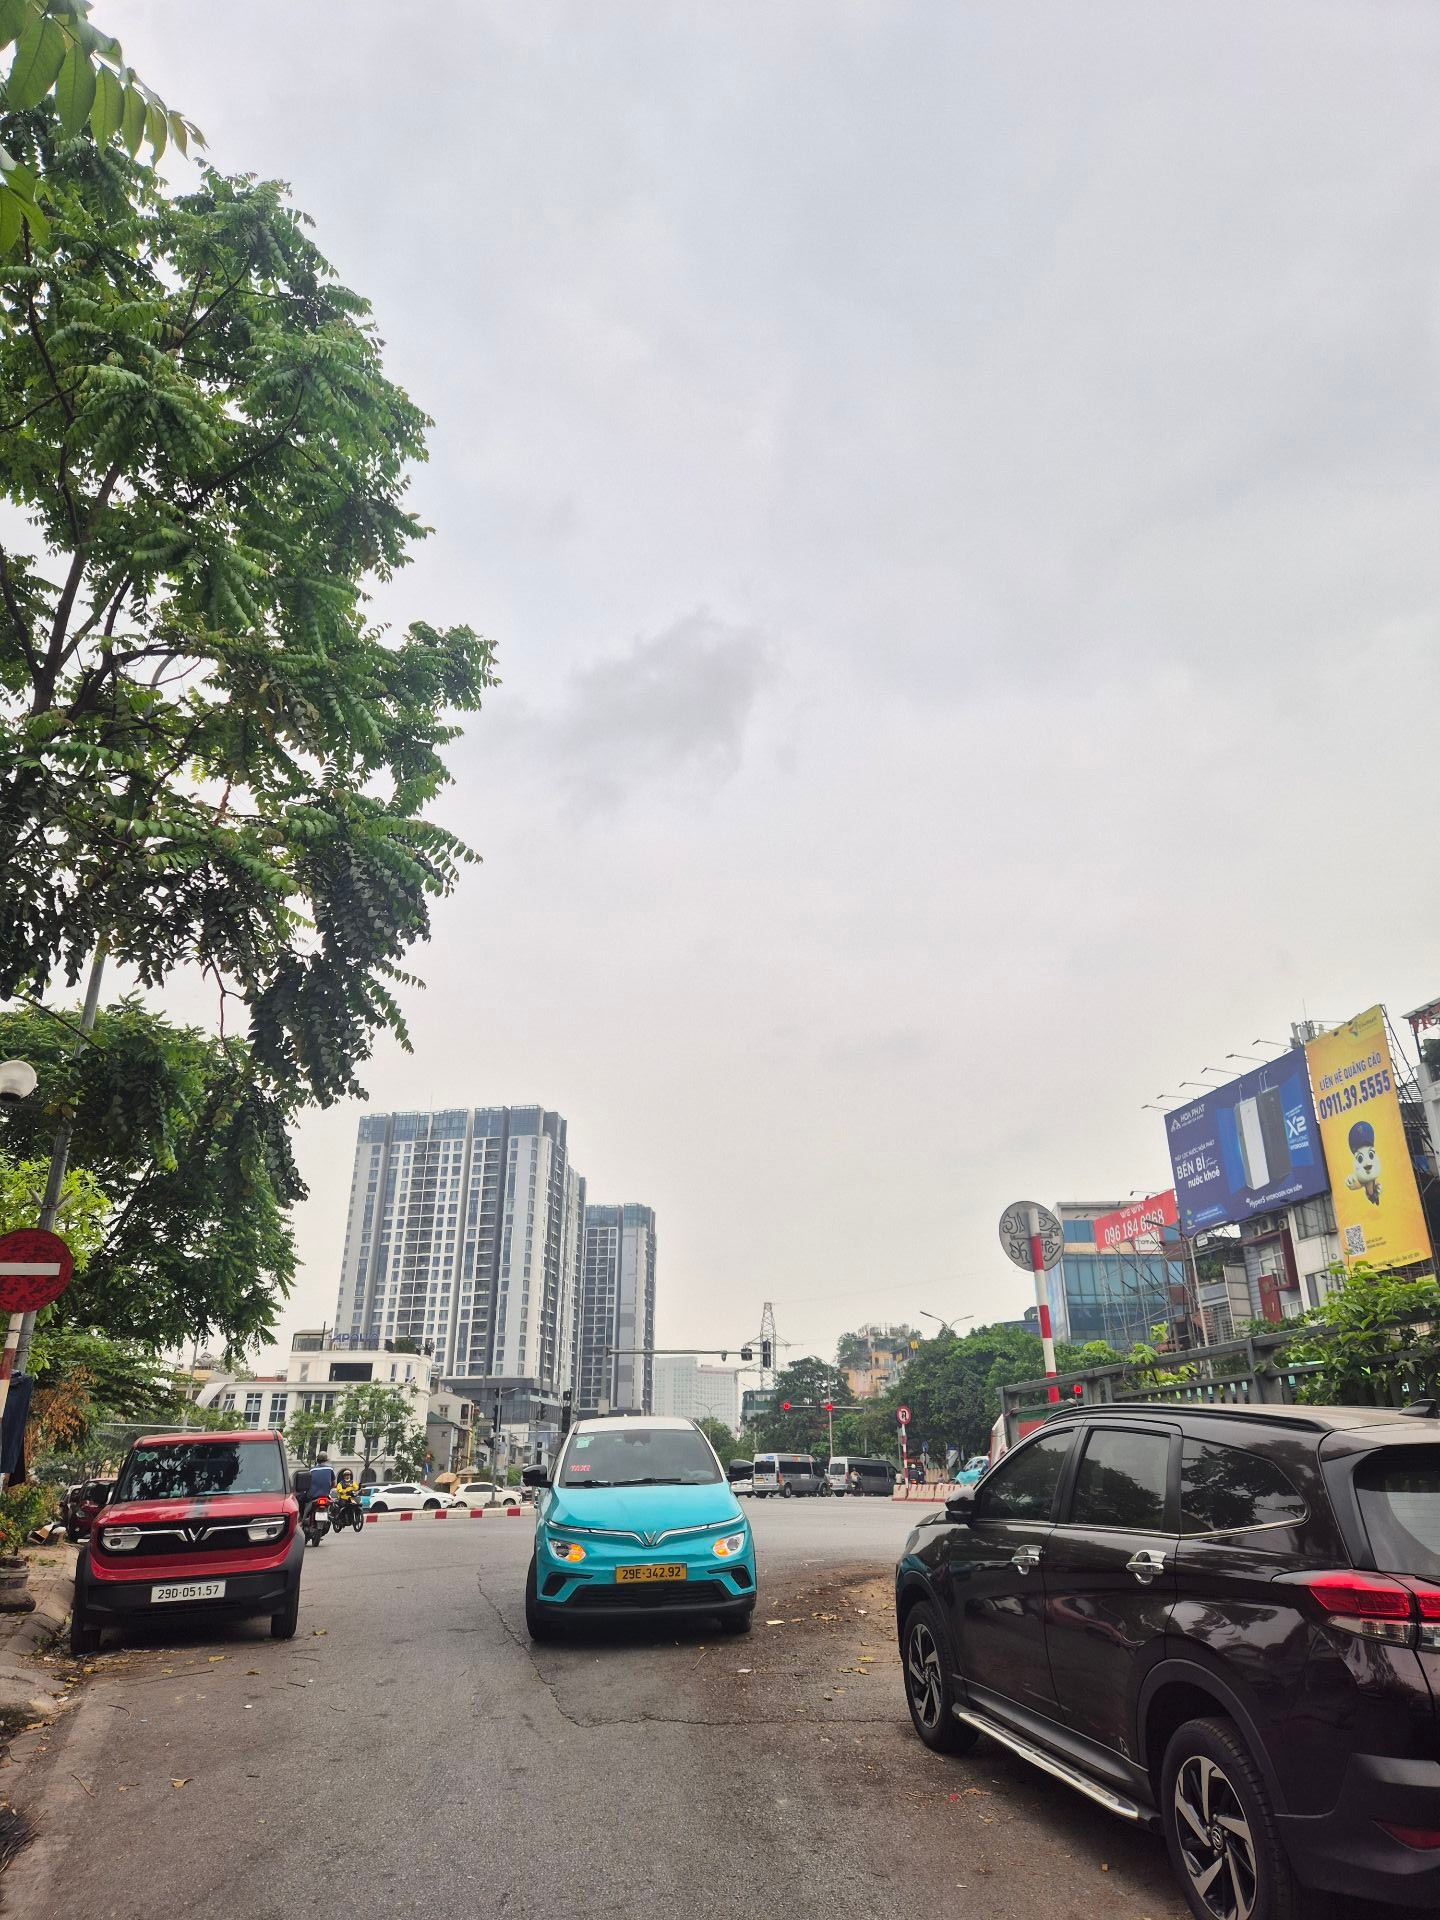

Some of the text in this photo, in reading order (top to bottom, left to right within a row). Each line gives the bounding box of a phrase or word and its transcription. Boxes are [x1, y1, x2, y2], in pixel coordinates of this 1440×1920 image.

[1319, 1073, 1333, 1091] LIÊN
[1334, 1068, 1343, 1085] HỆ
[1319, 1069, 1391, 1120] 0911.39.5555
[1286, 1115, 1307, 1138] X2
[1104, 1208, 1165, 1245] 096 184 6868
[333, 1333, 379, 1343] APOLLO
[570, 1464, 591, 1472] TAXI
[622, 1566, 681, 1580] 29E-342.92
[158, 1584, 219, 1599] 29D-051.57
